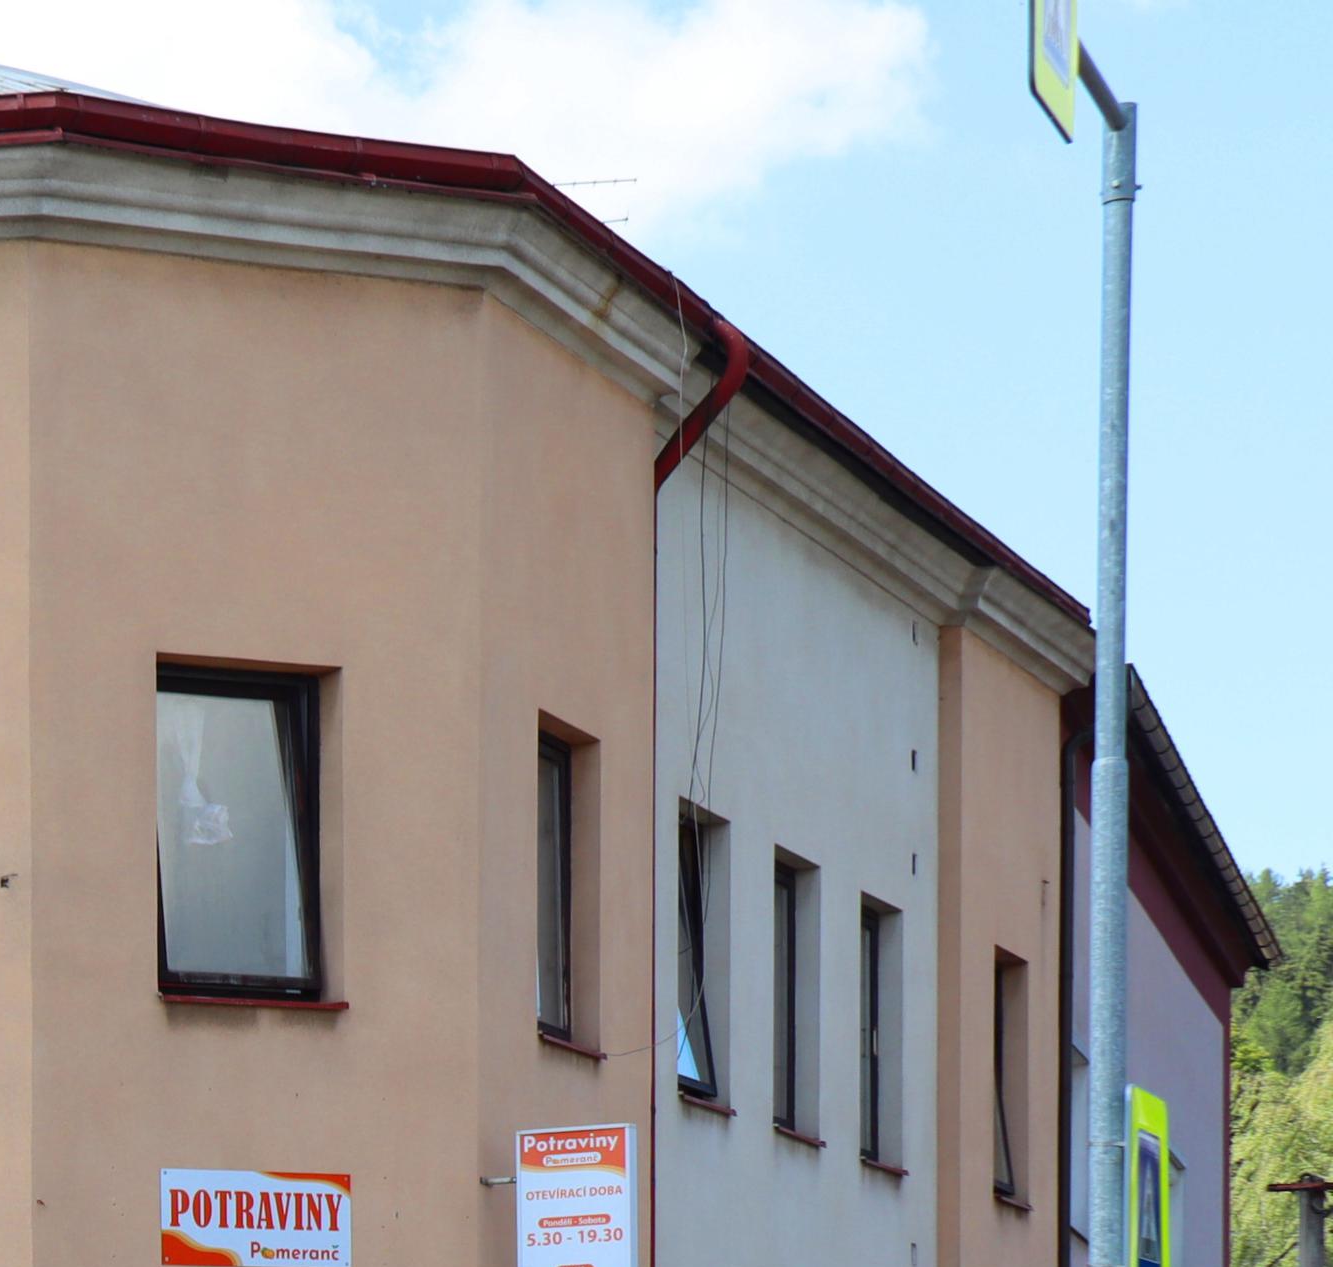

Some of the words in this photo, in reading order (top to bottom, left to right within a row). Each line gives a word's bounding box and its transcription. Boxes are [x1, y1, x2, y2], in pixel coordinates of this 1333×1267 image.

[523, 1133, 619, 1153] Potraviny
[525, 1186, 586, 1201] OTEVÍRACÍ
[589, 1184, 623, 1196] DOBA
[169, 1188, 343, 1232] POTRAVINY
[578, 1216, 606, 1225] Sobota
[526, 1231, 563, 1247] 5.30
[578, 1227, 624, 1243] 19.30
